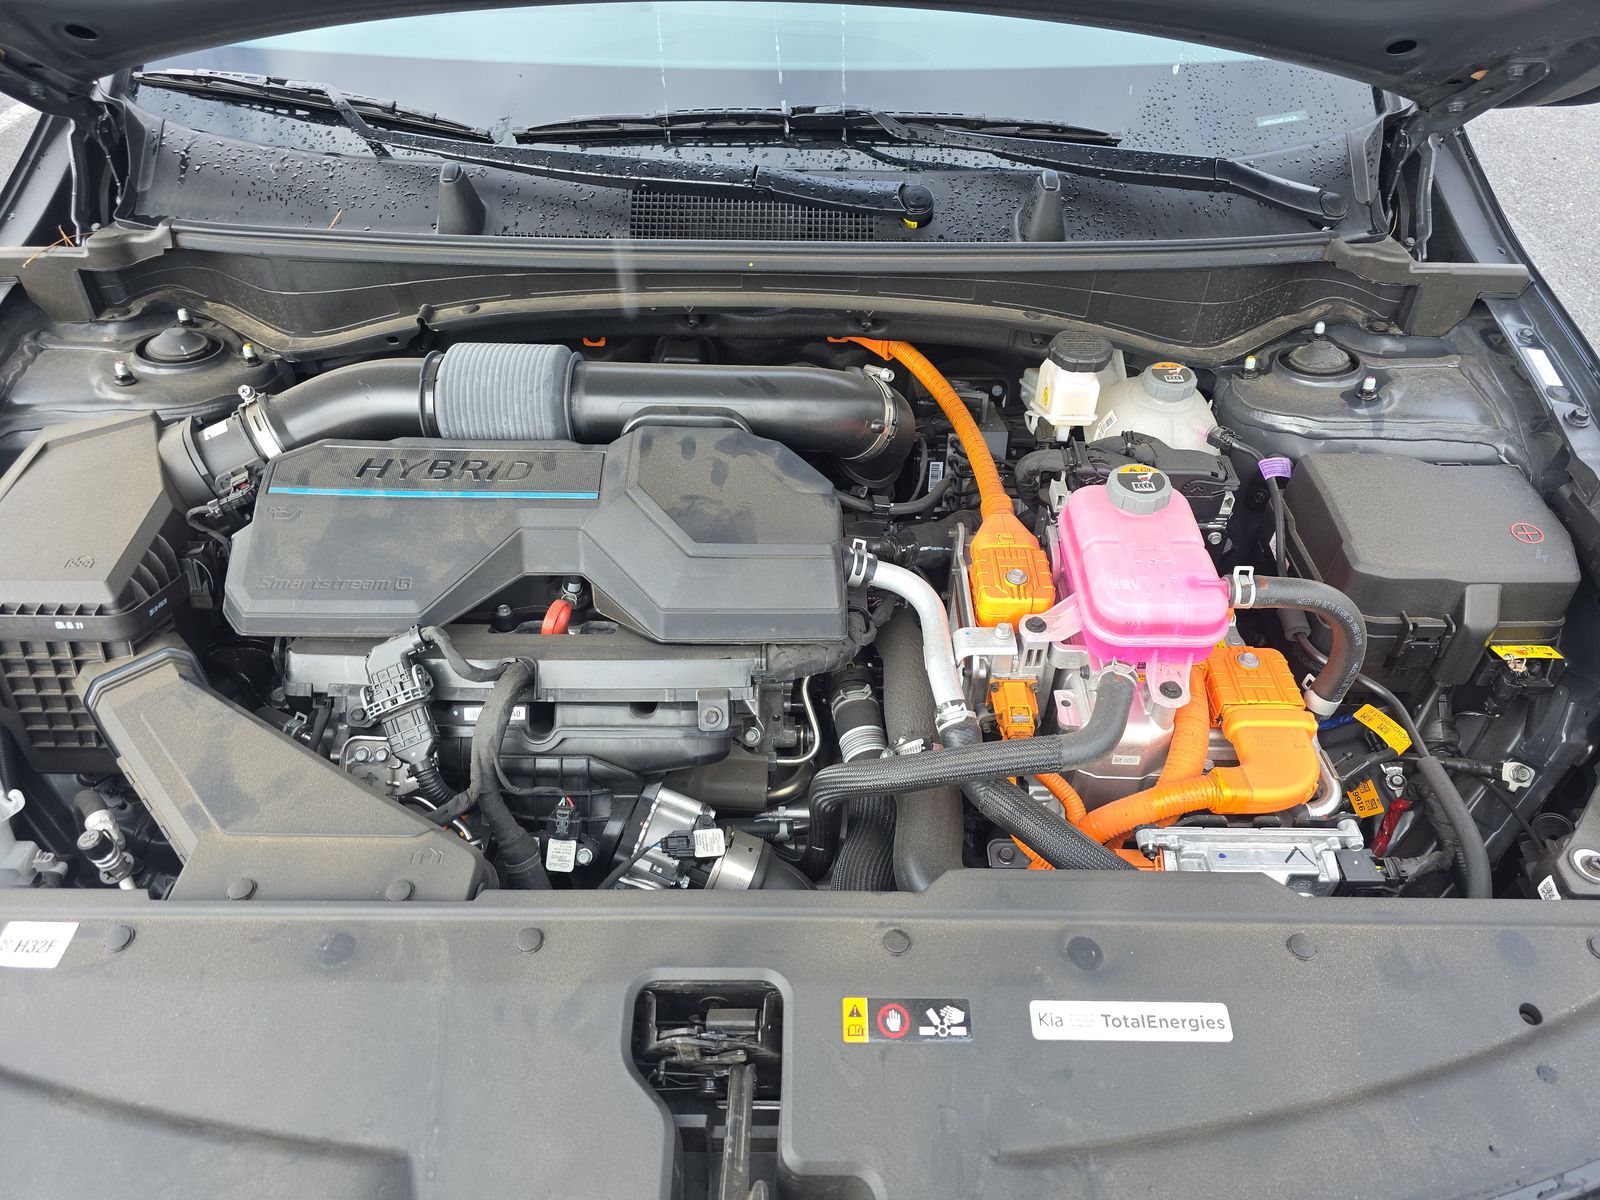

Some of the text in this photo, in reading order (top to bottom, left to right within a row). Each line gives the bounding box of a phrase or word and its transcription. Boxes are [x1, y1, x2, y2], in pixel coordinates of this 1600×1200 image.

[354, 456, 535, 482] HYBRID
[256, 575, 392, 591] Smartstream
[13, 939, 58, 954] H32F
[1038, 1012, 1064, 1028] Kia
[1100, 1014, 1226, 1032] TotalEnergies
